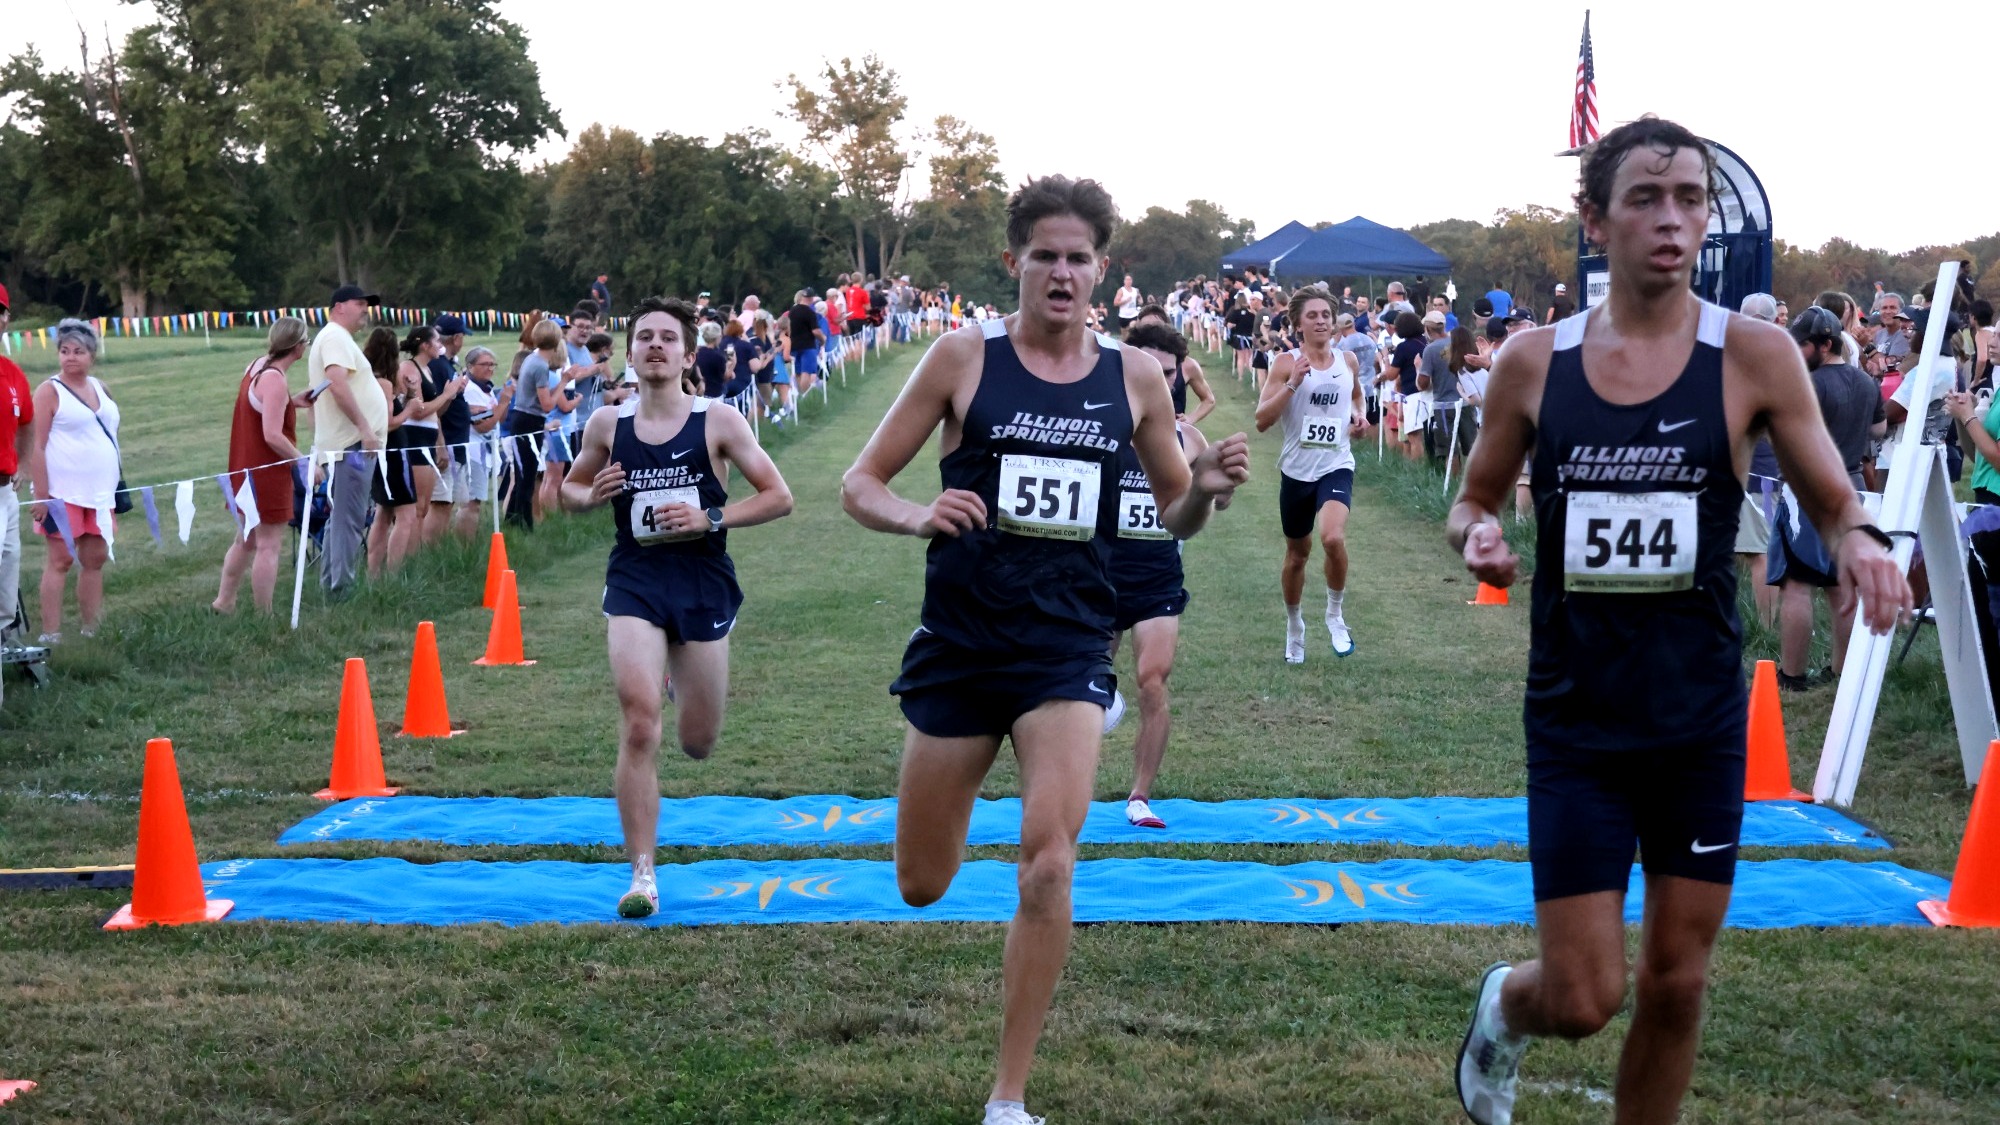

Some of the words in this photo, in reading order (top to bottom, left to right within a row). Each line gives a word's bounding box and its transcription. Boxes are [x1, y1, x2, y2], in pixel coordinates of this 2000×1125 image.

[1309, 392, 1339, 406] MBU
[1011, 411, 1103, 434] ILLINOIS
[990, 425, 1119, 453] SPRINGFIELD
[1307, 424, 1336, 442] 598
[1568, 446, 1686, 463] ILLINOIS
[630, 465, 689, 480] ILLINOIS
[1015, 476, 1081, 521] 551
[1585, 518, 1677, 569] 544
